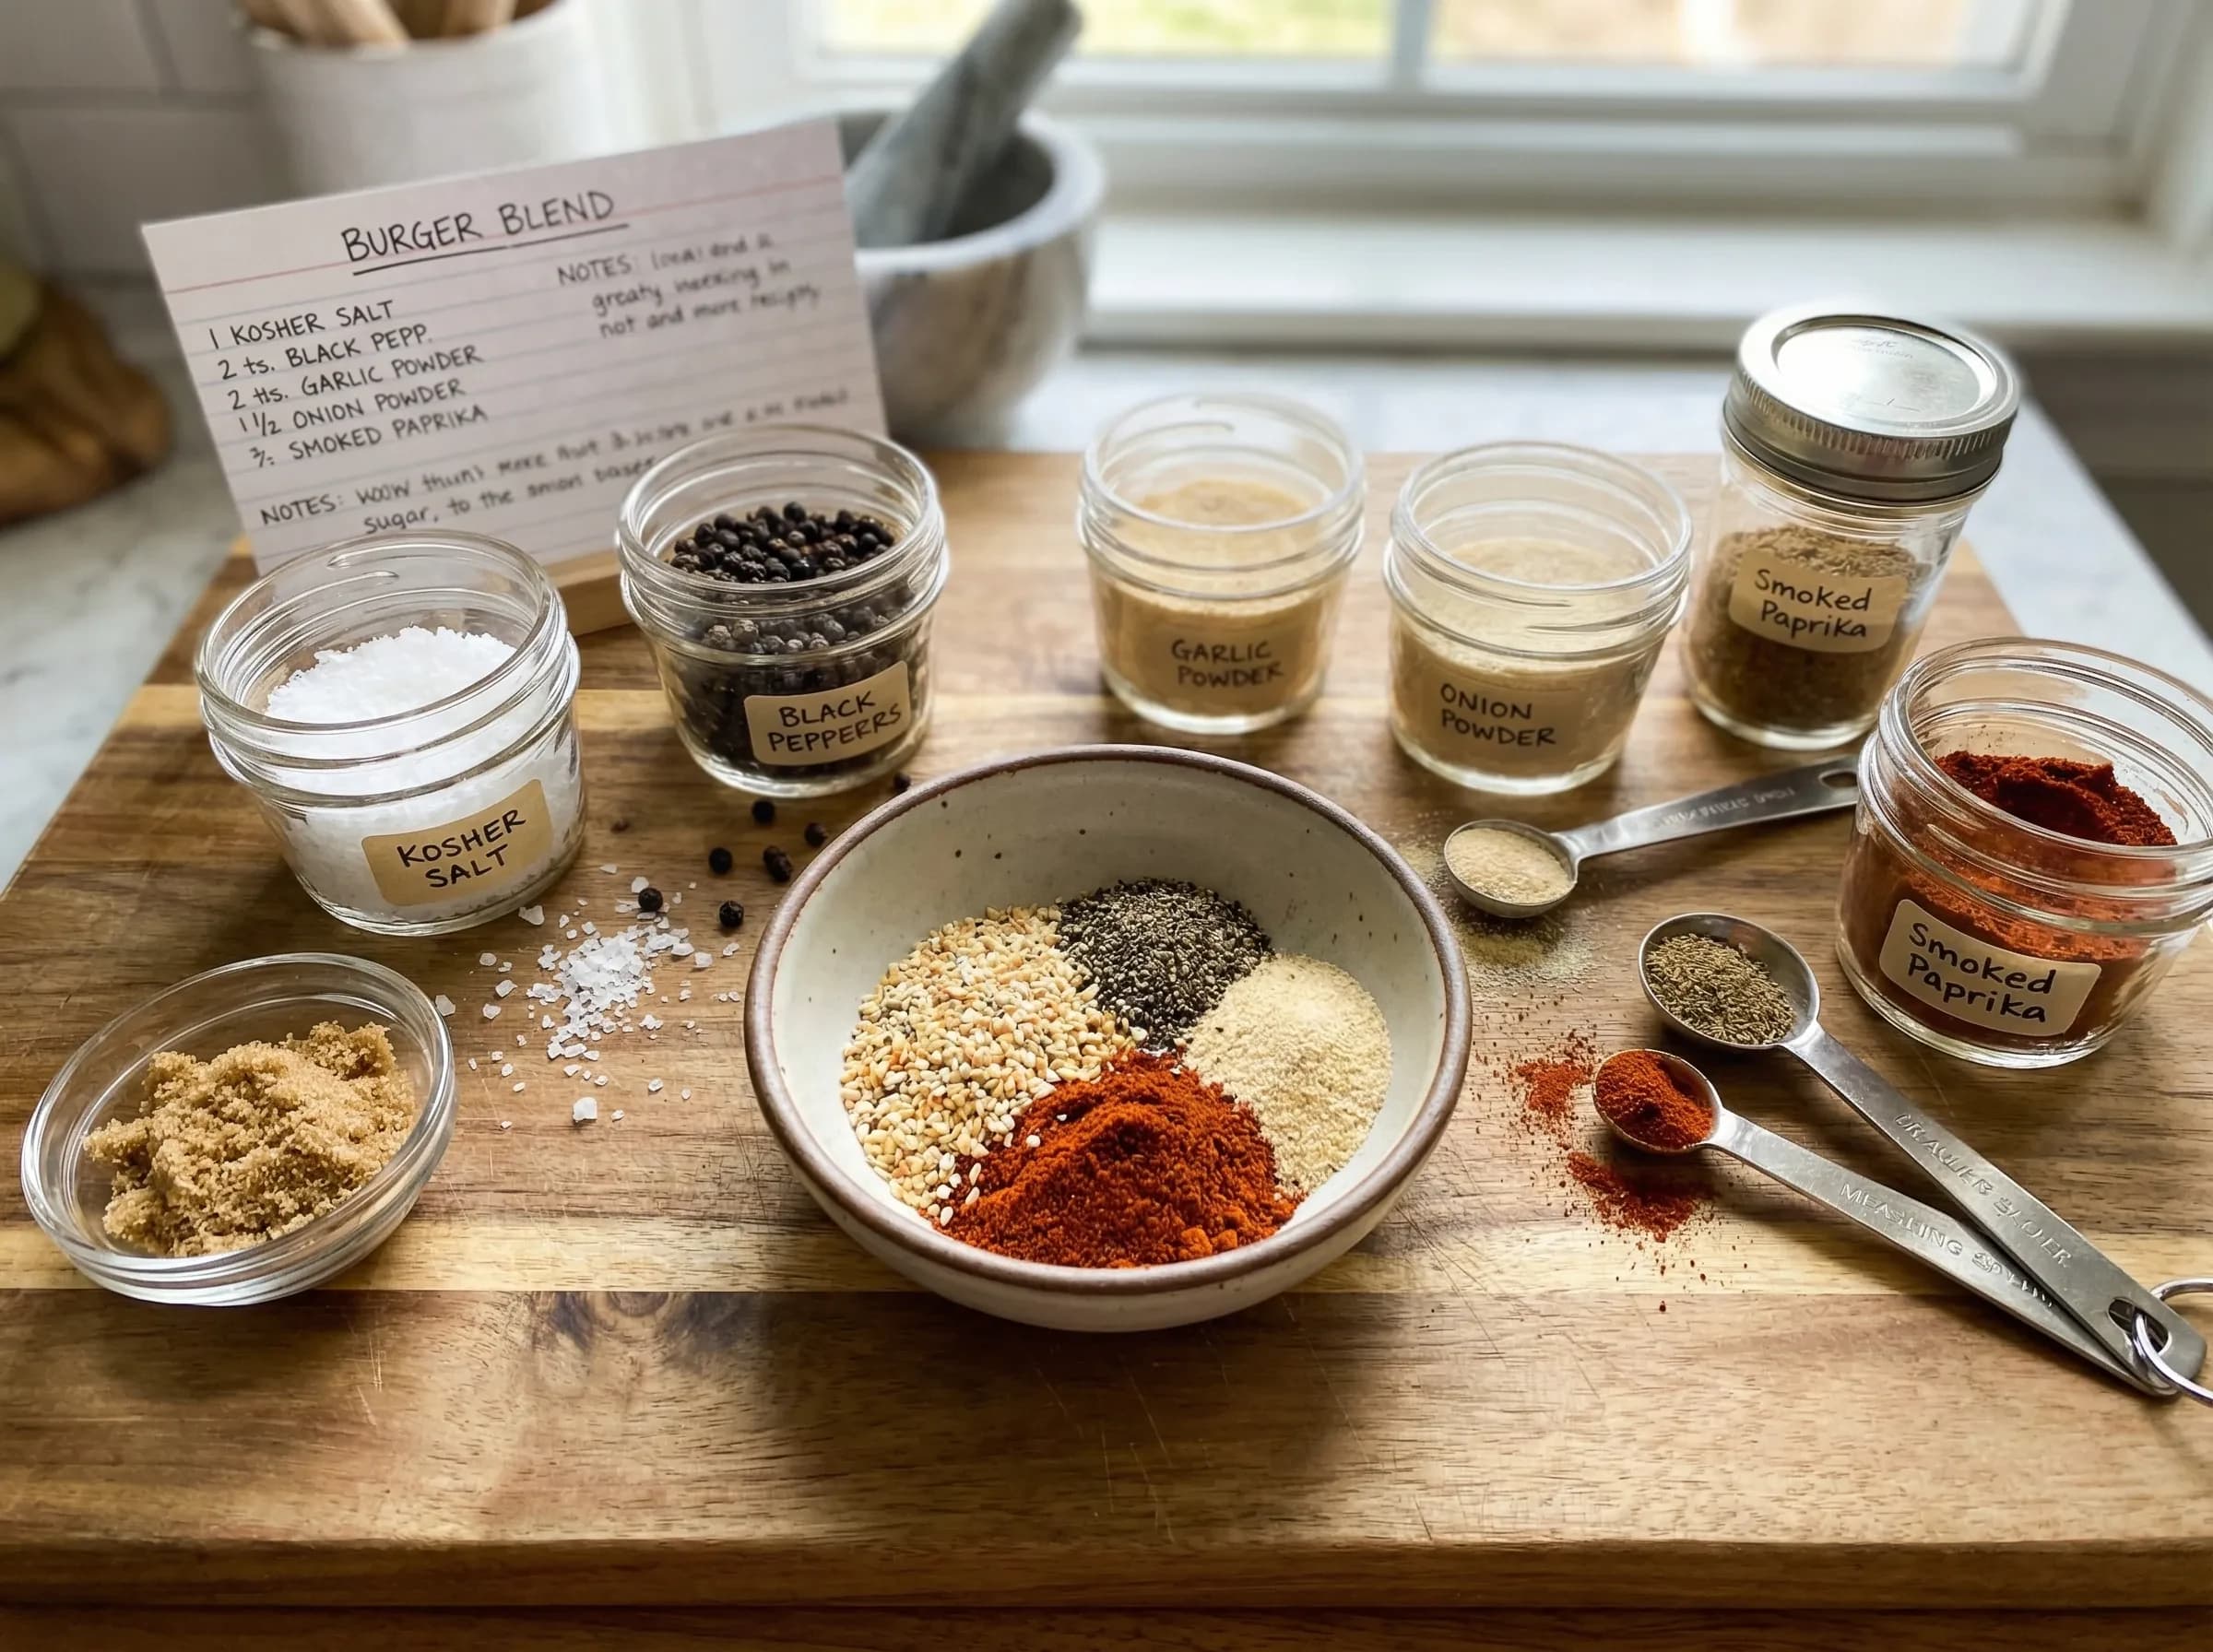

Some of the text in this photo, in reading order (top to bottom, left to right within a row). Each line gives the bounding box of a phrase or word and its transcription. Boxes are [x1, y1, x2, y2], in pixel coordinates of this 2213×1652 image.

[341, 191, 614, 262] BURGER BLEND
[230, 312, 325, 346] KOSHER
[336, 300, 394, 326] SALT
[218, 359, 237, 381] 2
[285, 337, 361, 368] BLACK
[228, 390, 246, 410] 2
[301, 366, 384, 396] GARLIC
[392, 345, 484, 379] POWDER
[293, 399, 365, 430] ONION
[374, 378, 466, 412] POWDER
[289, 426, 382, 461] SMOKED
[392, 405, 490, 439] PAPRIKA
[260, 492, 344, 525] NOTES:
[363, 506, 440, 535] sugar,
[446, 497, 471, 516] to
[479, 489, 515, 508] the
[1755, 568, 1872, 611] Smoked
[1761, 599, 1866, 639] Paprika
[1171, 638, 1272, 664] GARLIC
[1178, 660, 1284, 688] POWDER
[778, 690, 875, 727] BLACK
[1440, 683, 1533, 719] ONION
[1441, 709, 1556, 747] POWDER
[396, 809, 527, 867] KOSHER
[425, 844, 508, 888] SALT
[1909, 922, 2056, 994] Smoked
[1908, 952, 2046, 1023] Paprika
